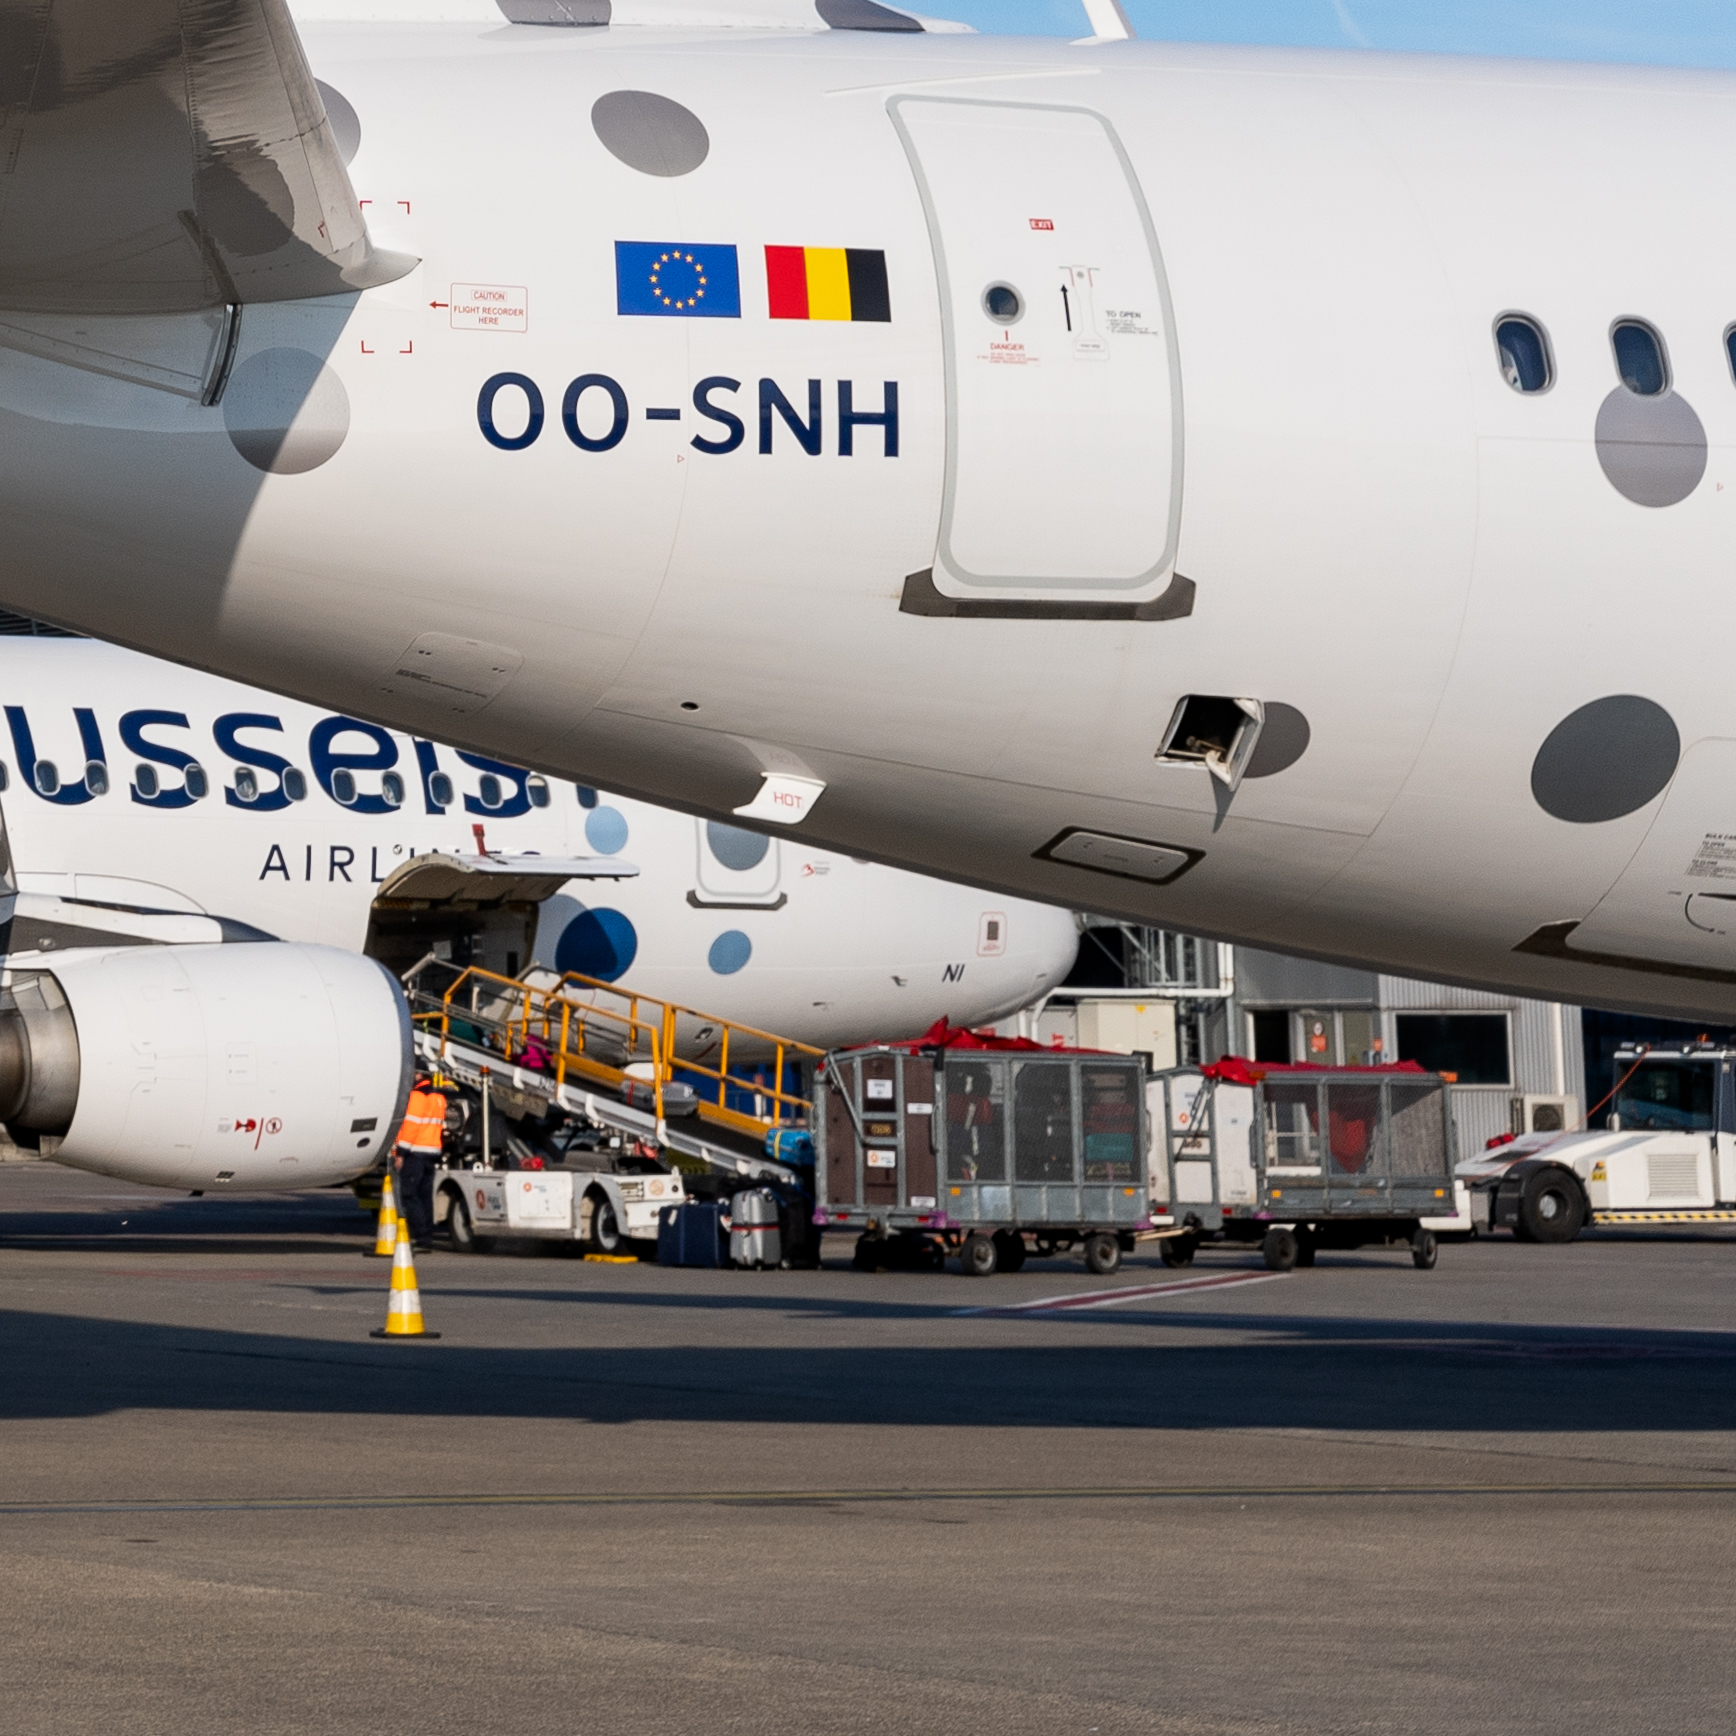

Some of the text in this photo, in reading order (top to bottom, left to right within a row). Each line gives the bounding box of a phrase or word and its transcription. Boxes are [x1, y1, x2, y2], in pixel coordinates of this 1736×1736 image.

[473, 291, 505, 301] CAUTION
[453, 305, 524, 317] FLIGHT RECORDER
[1106, 310, 1117, 318] TO
[478, 317, 499, 325] HERE
[990, 343, 1025, 351] DANGER
[476, 371, 899, 458] OO-SNH
[773, 791, 803, 809] HOT
[941, 964, 965, 982] NI
